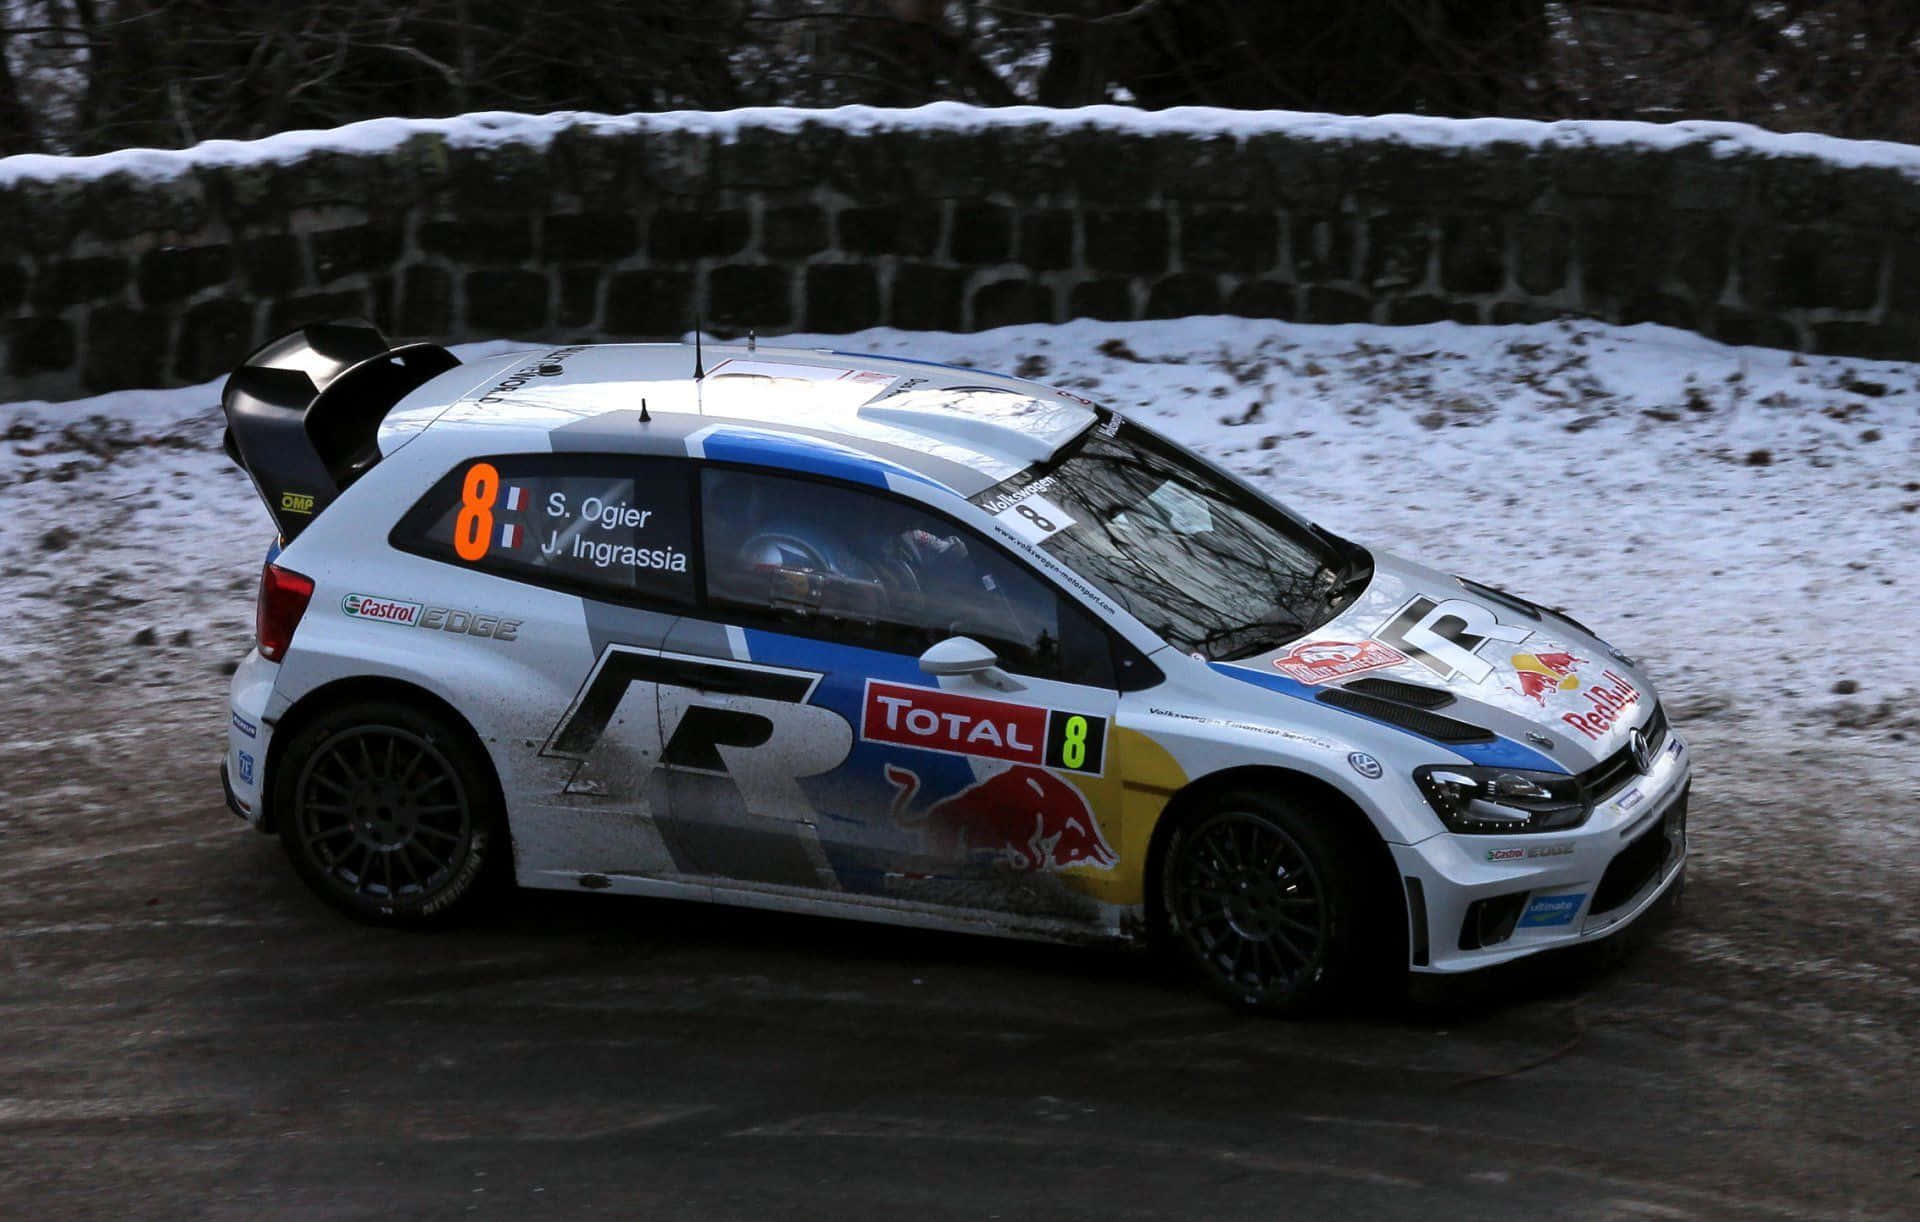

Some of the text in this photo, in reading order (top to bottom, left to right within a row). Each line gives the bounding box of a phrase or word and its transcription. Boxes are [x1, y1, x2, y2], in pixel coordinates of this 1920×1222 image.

[282, 495, 313, 510] OMP
[454, 463, 499, 561] 8
[547, 492, 652, 530] S. Ogier
[982, 475, 1056, 514] Volkswagen
[1016, 504, 1057, 533] 8
[541, 530, 688, 573] J. Ingrassia
[994, 524, 1116, 615] www.volkswagen-motorsport.com
[360, 598, 525, 642] Castrol EDGE
[877, 695, 1033, 752] TOTAL
[1063, 715, 1088, 769] 8
